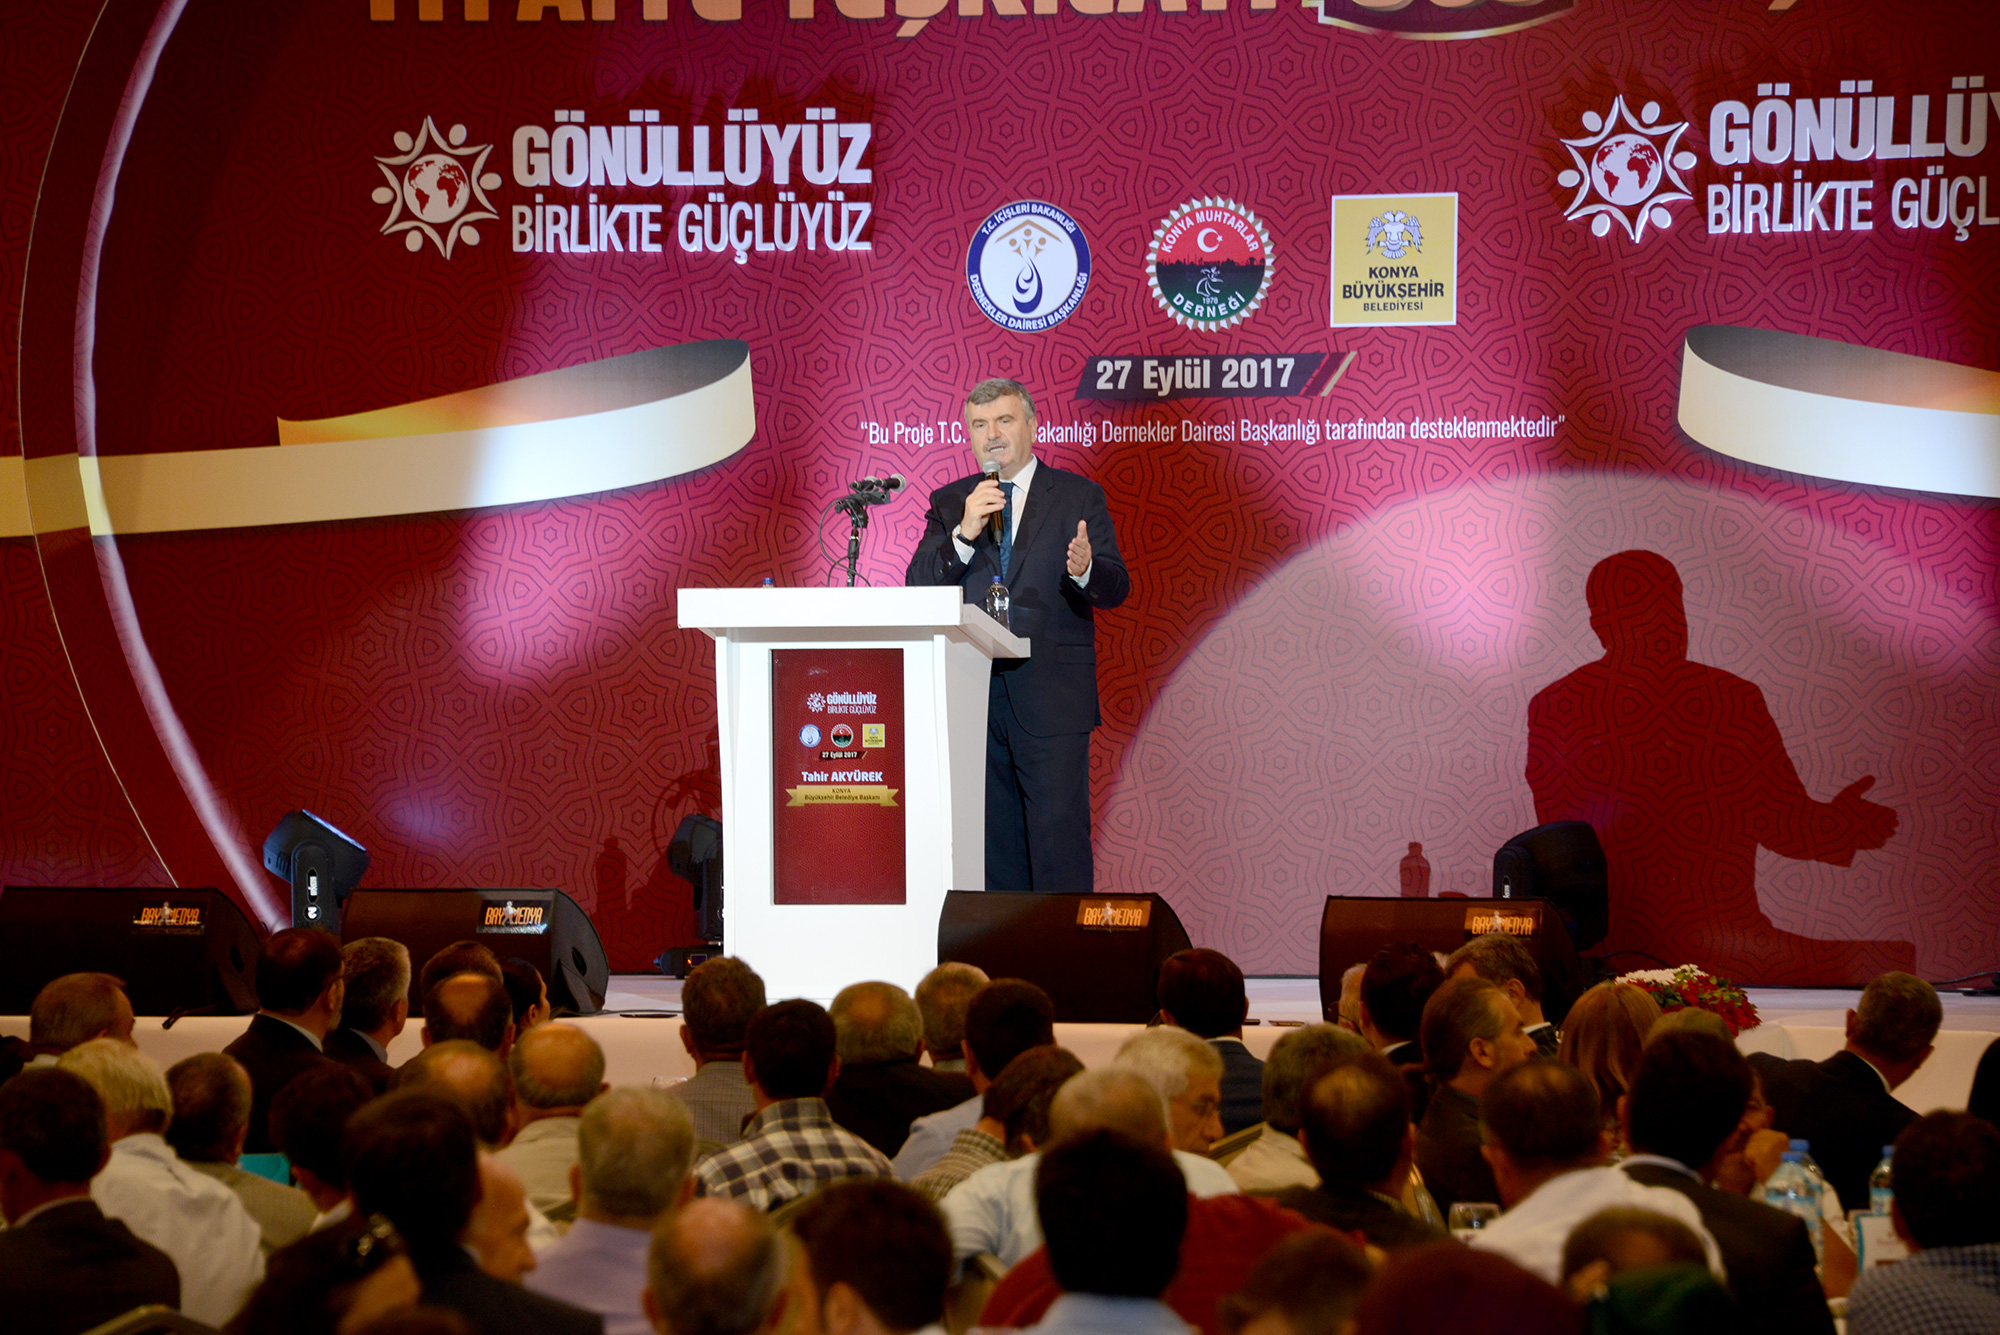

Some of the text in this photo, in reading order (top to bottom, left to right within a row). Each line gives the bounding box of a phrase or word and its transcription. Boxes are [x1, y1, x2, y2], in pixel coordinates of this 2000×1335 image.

[512, 107, 872, 187] GÖNÜLLÜYÜZ
[1707, 165, 2000, 242] BİRLİKTE GÜÇL
[512, 191, 872, 265] BİRLİKTE GÜÇLÜYÜZ
[981, 202, 1076, 235] T.C. İÇİŞLERİ BAKANLIĞI
[1161, 209, 1259, 253] KONYA MUHTARLAR
[1369, 266, 1419, 279] KONYA
[1342, 279, 1445, 300] BÜYÜKŞEHİR
[970, 272, 1088, 331] DERNEKLER DAİRESİ BAŞKANLIĞI
[1172, 290, 1246, 318] DERNEĞİ
[1363, 299, 1424, 311] BELEDİYESİ
[1096, 357, 1295, 396] 27 Eylül 2017
[894, 421, 934, 448] Proje
[937, 421, 966, 444] T.C.
[1034, 420, 1098, 447] akanlığı
[1102, 419, 1176, 444] Dernekler
[1181, 418, 1235, 443] Dairesi
[1240, 418, 1321, 446] Başkanlığı
[1325, 416, 1405, 441] tarafından
[826, 691, 877, 705] GÖNÜLLÜYÜZ
[827, 704, 877, 715] BİRLİKTE GÜÇLÜYÜZ
[801, 769, 883, 782] Tahir AKYÜREK
[140, 907, 161, 926] BAY
[484, 907, 505, 925] BAY
[1083, 908, 1104, 926] BAY
[1471, 916, 1492, 934] BAY
